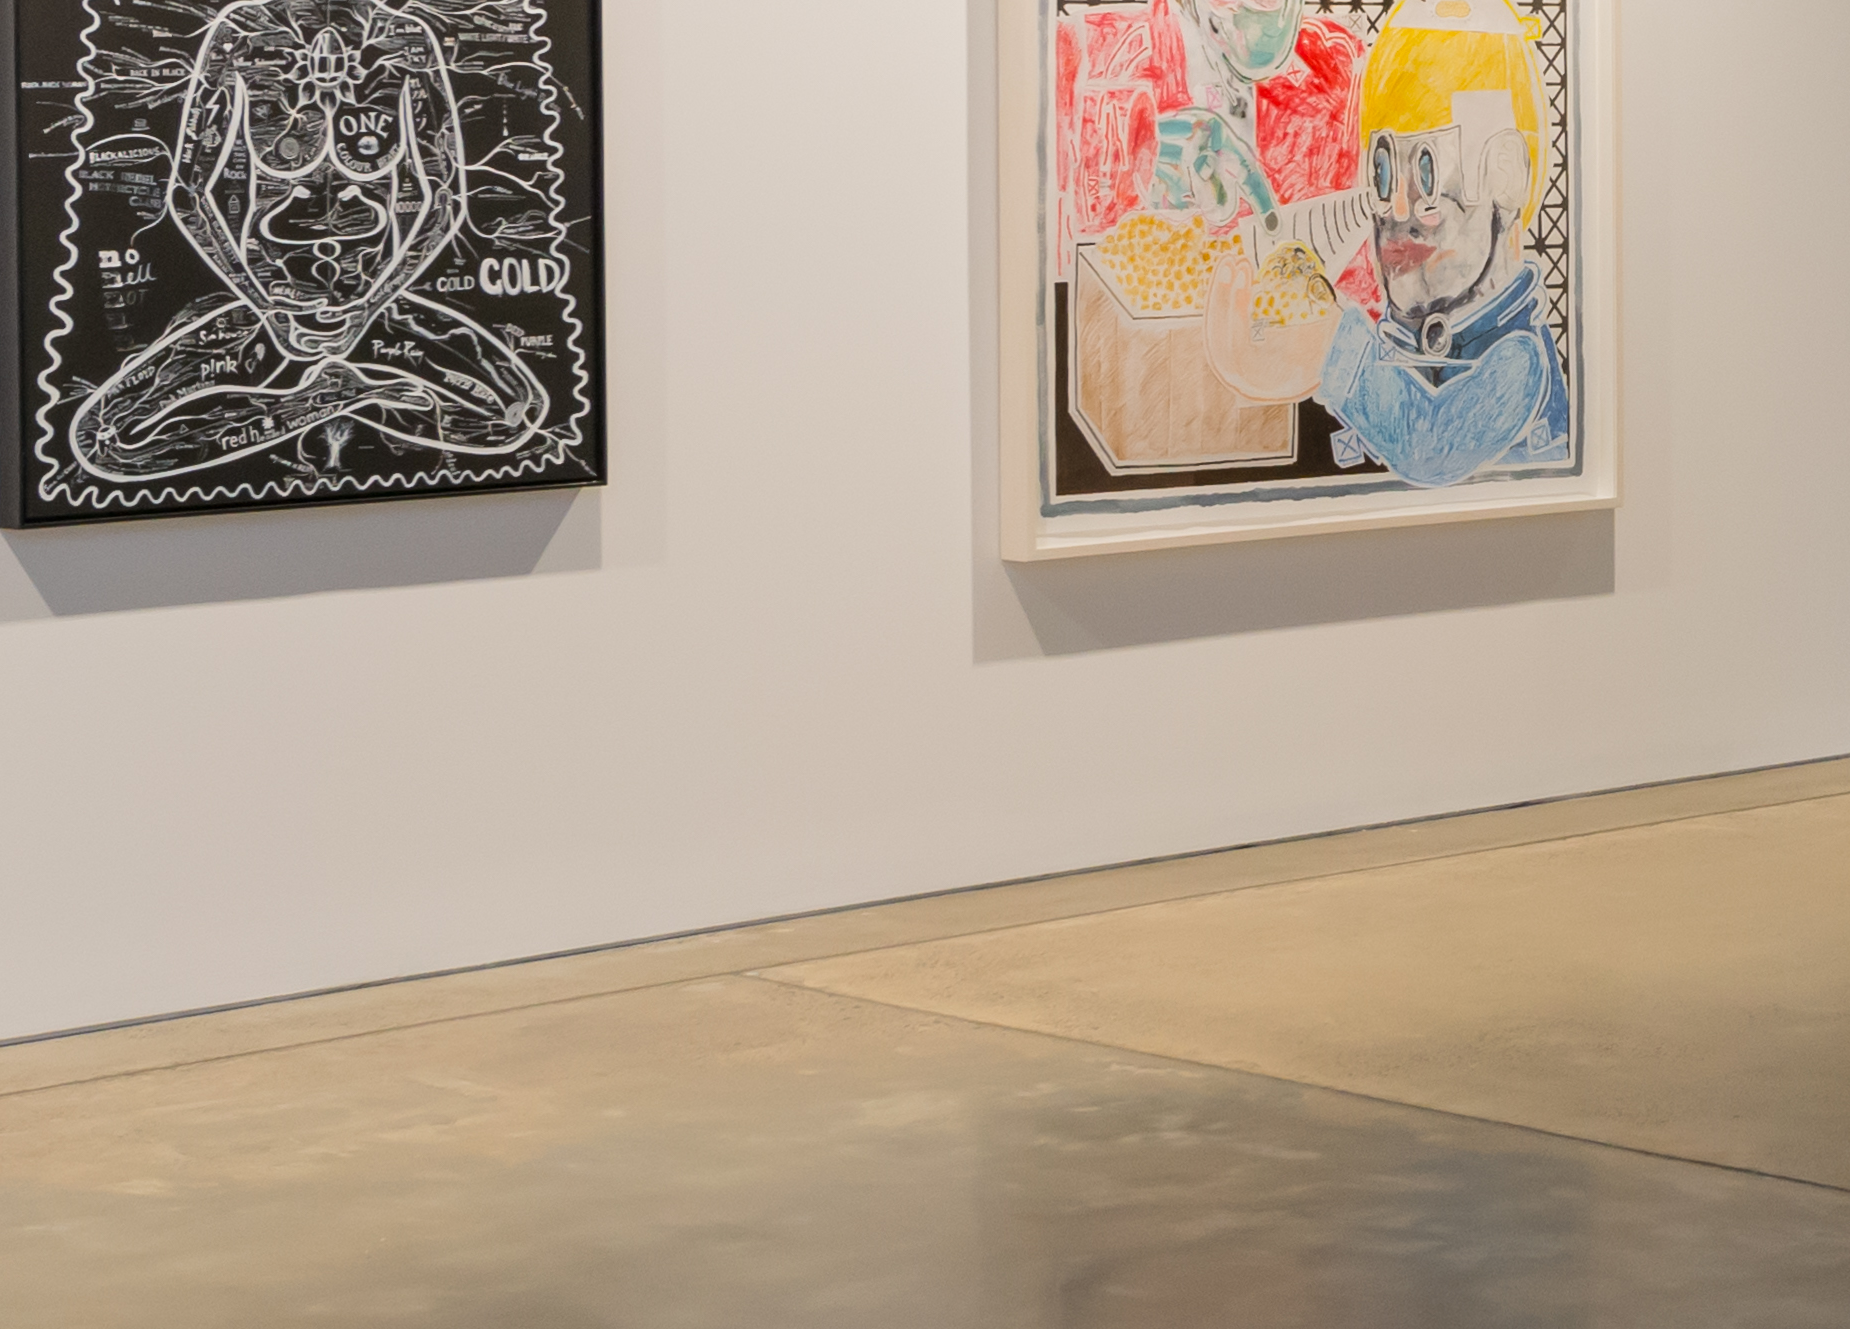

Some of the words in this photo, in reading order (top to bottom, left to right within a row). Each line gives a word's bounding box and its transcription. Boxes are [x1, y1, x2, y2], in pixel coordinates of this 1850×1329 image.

[339, 112, 393, 139] ONE
[221, 427, 247, 450] red
[286, 406, 335, 429] woman
